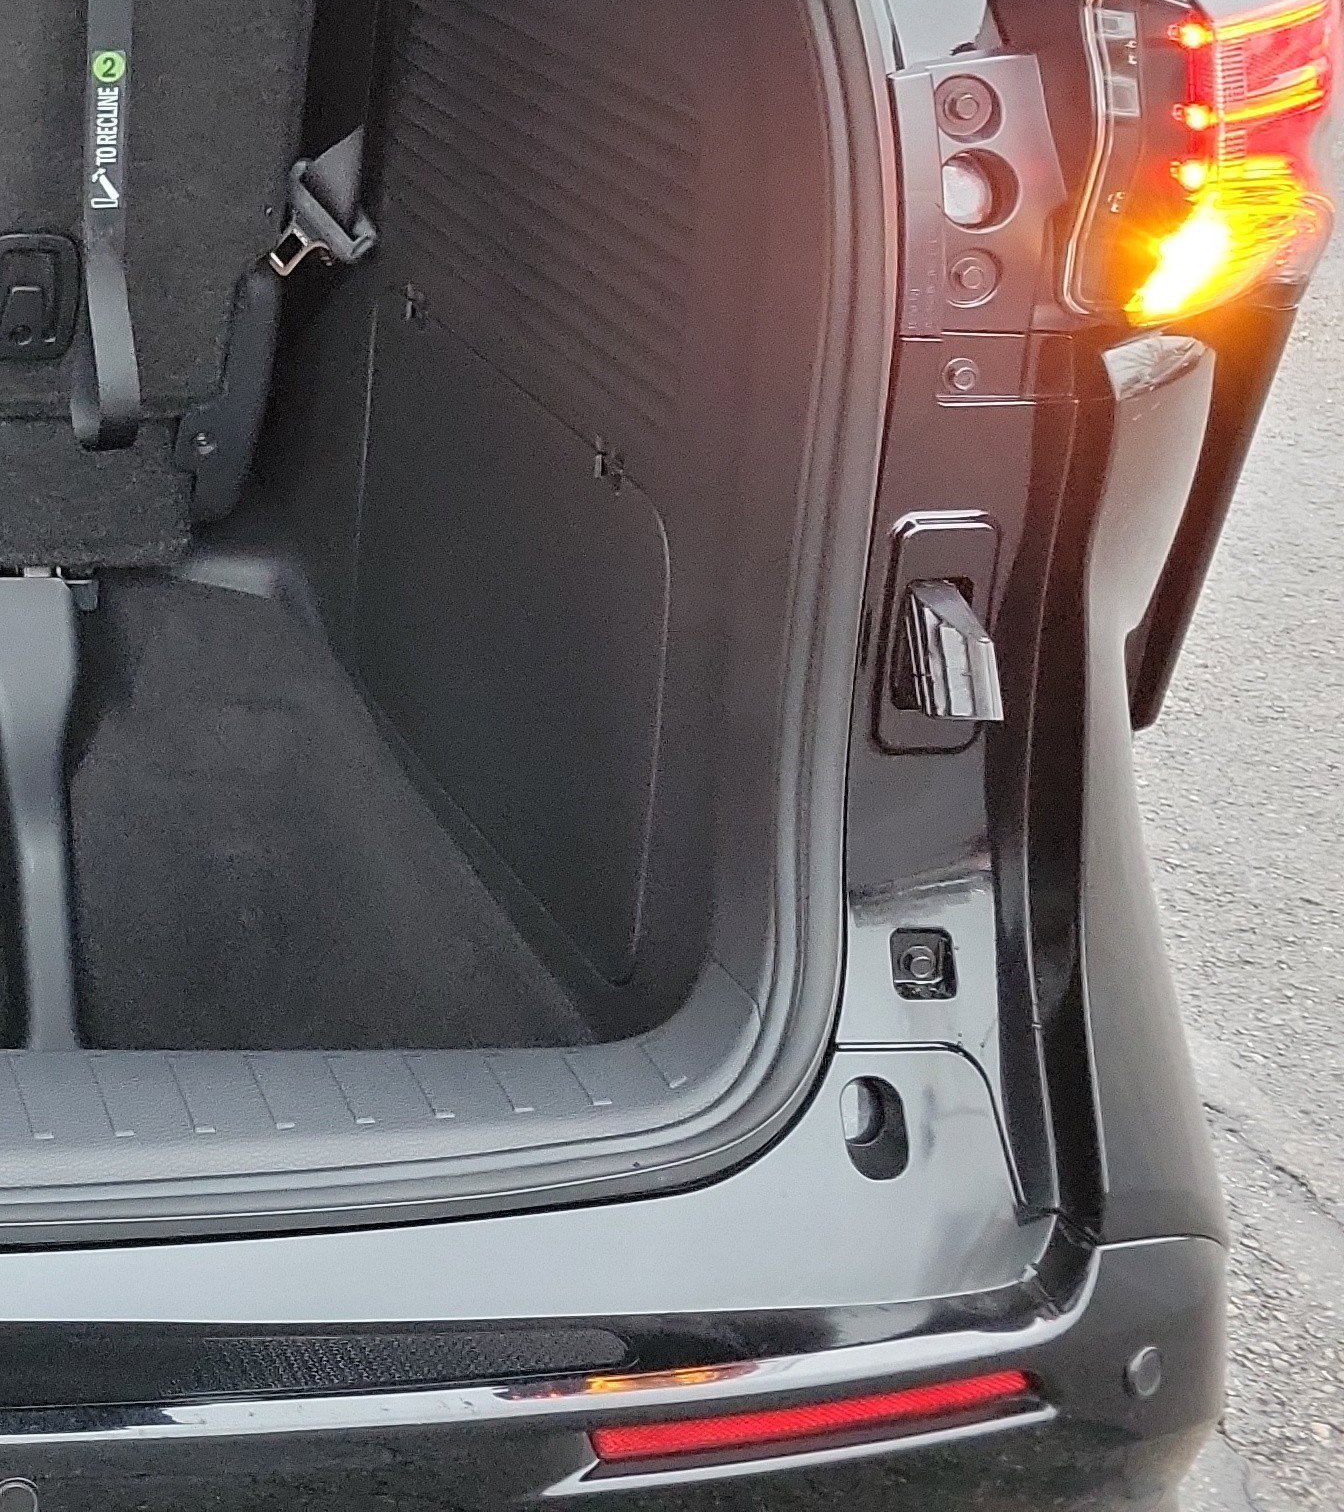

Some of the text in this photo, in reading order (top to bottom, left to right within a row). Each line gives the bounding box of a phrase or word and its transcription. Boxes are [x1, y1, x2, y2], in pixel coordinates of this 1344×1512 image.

[102, 56, 117, 78] 2
[95, 86, 119, 167] TO RECLINE
